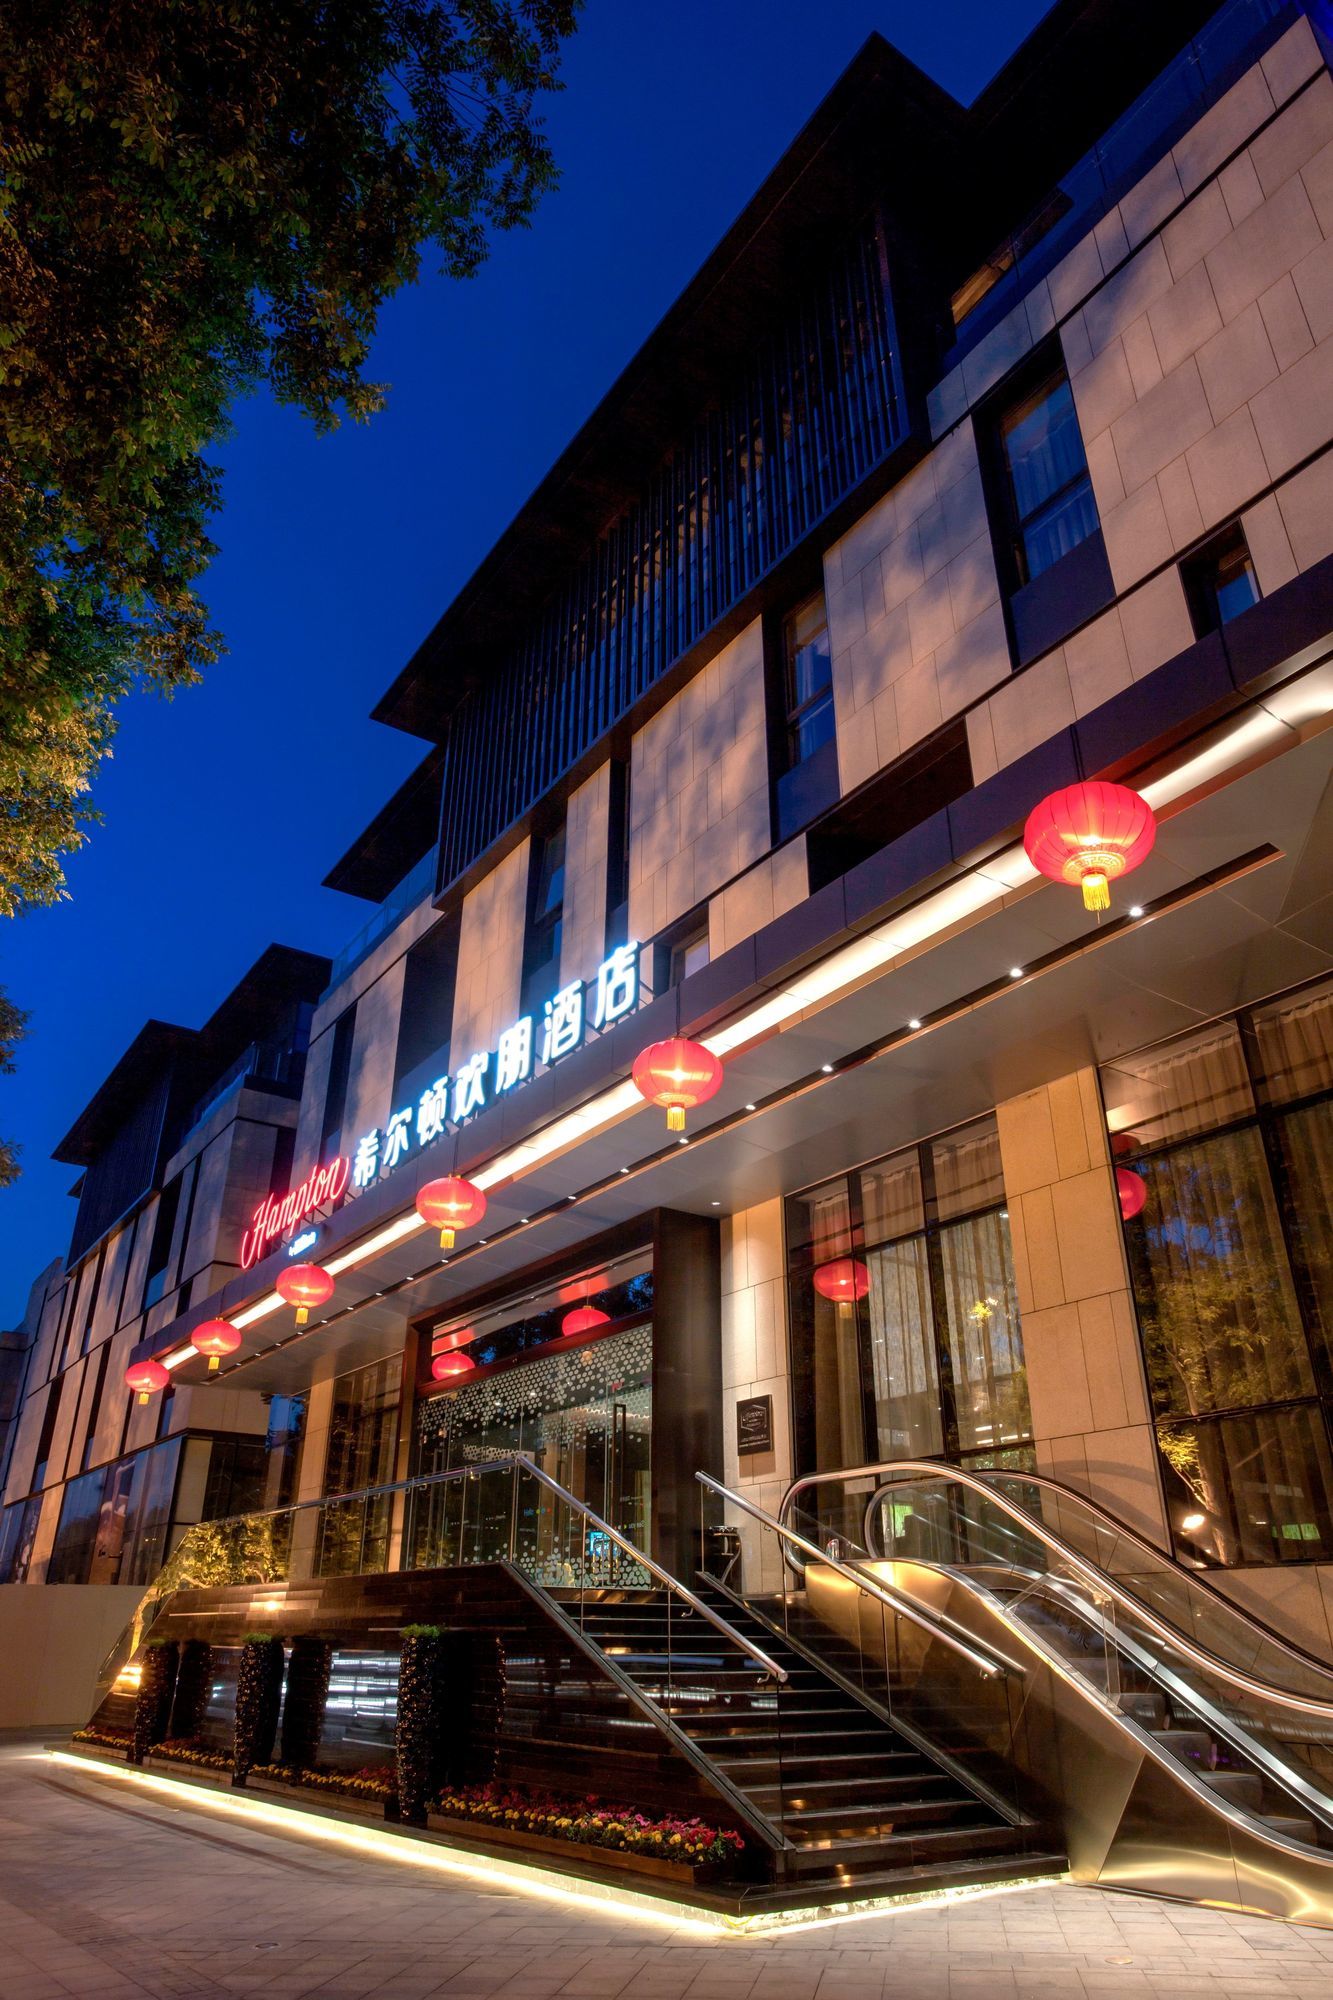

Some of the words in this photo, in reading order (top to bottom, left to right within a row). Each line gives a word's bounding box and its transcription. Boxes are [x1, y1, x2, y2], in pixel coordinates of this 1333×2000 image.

[353, 941, 639, 1187] 希尔顿欢朋酒店
[241, 1156, 350, 1269] Hampton
